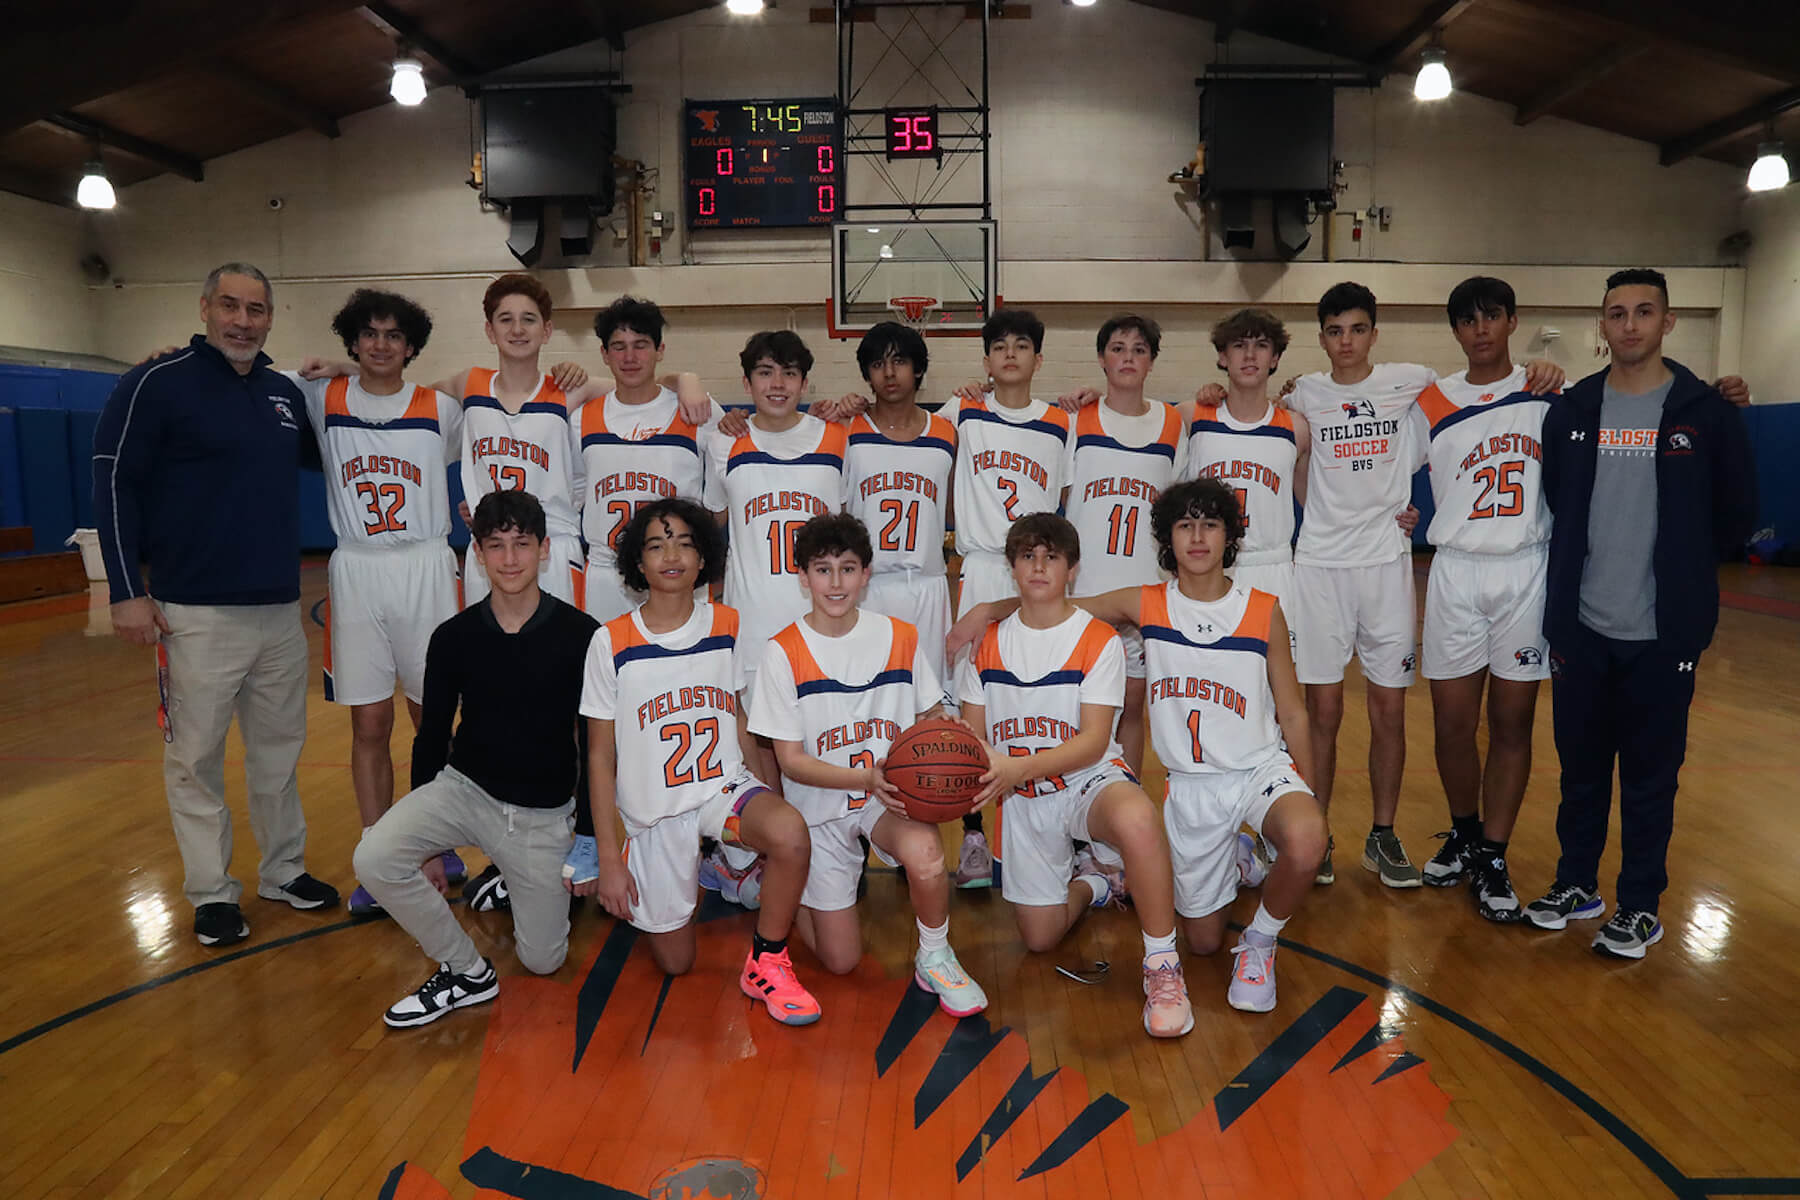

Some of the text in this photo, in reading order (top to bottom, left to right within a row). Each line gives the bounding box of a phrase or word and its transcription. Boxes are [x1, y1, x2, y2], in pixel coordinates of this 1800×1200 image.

[741, 105, 801, 132] 7:45
[892, 116, 932, 151] 35
[716, 147, 733, 176] 0
[817, 145, 834, 173] 0
[699, 188, 715, 215] 0
[818, 185, 834, 212] 0
[1321, 420, 1398, 442] FIELDSTON
[1334, 439, 1389, 459] SOCCER
[973, 450, 1048, 491] FIELDSTON
[1352, 459, 1373, 472] BVS
[355, 481, 407, 536] 32
[997, 476, 1023, 522] 2
[1083, 477, 1159, 504] FIELDSTO
[1468, 460, 1524, 520] 25
[607, 500, 655, 552] 2
[880, 498, 920, 551] 21
[1107, 504, 1139, 557] 11
[637, 686, 736, 731] FIELDSTON
[1151, 677, 1246, 720] FIELDSTON
[660, 716, 724, 788] 22
[912, 742, 980, 761] SPALDING
[1186, 709, 1205, 763] 1
